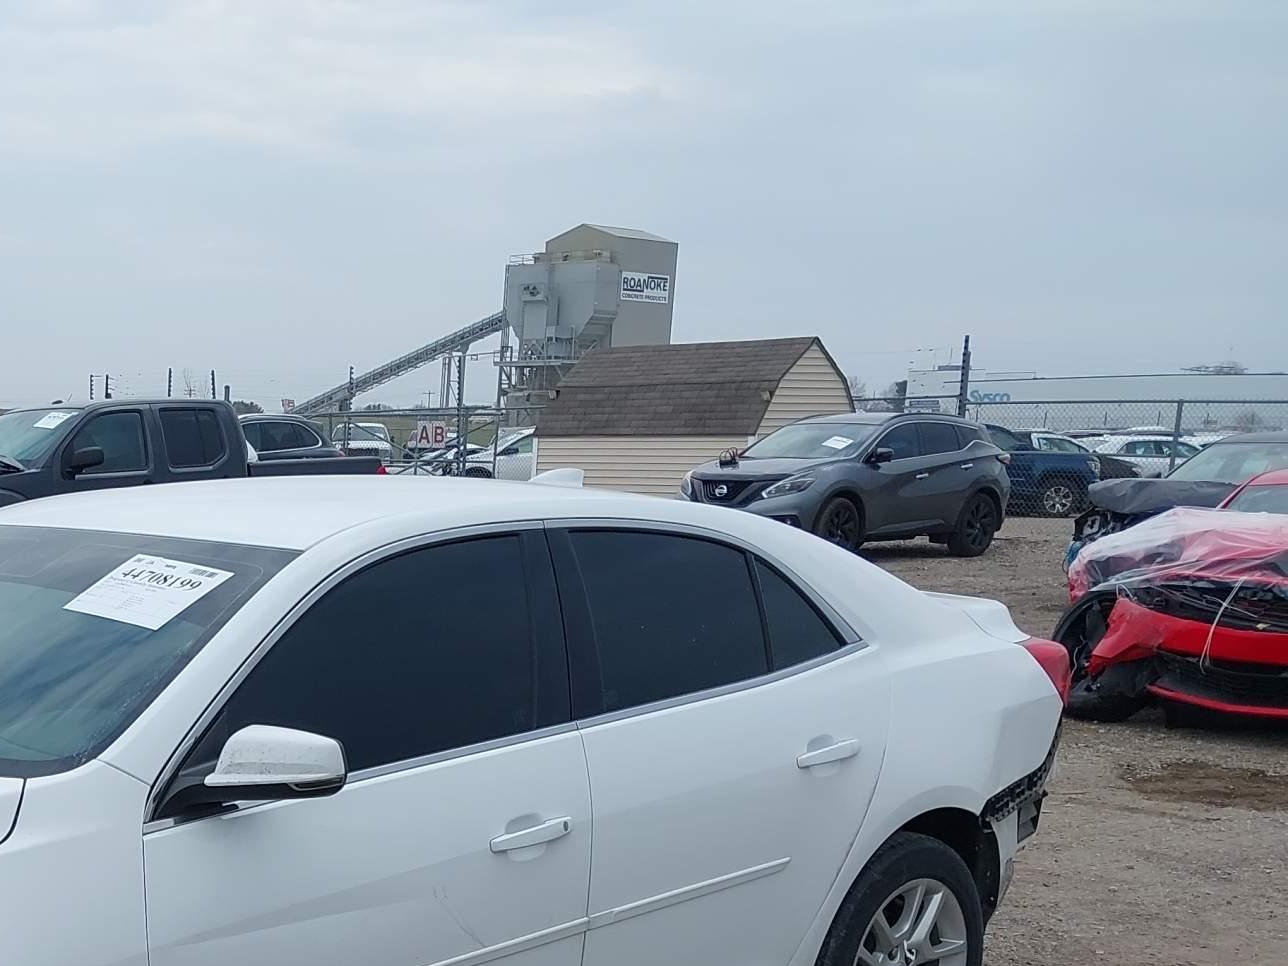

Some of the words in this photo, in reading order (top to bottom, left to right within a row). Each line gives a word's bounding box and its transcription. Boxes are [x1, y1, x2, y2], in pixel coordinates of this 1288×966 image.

[622, 276, 669, 292] ROANOKE
[418, 425, 430, 444] A
[434, 425, 445, 444] B
[122, 567, 202, 592] 44708199
